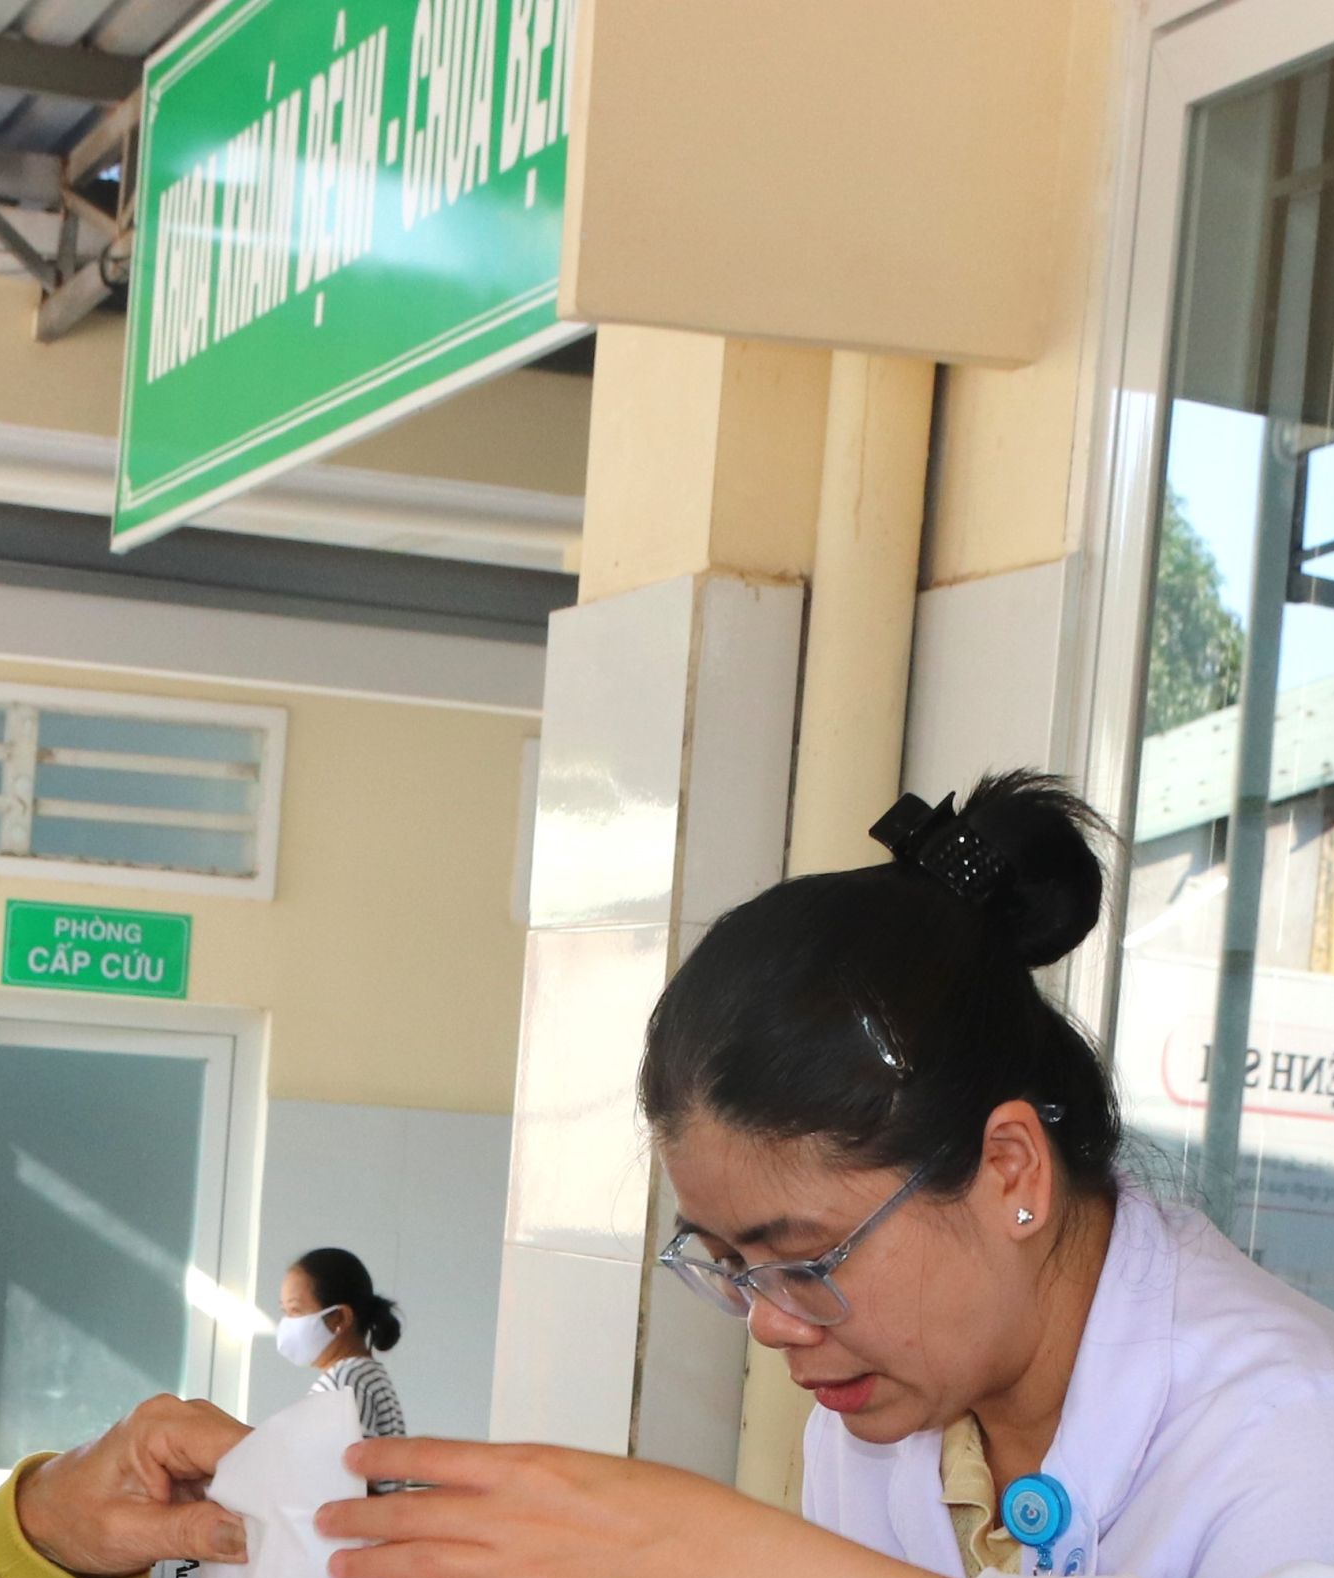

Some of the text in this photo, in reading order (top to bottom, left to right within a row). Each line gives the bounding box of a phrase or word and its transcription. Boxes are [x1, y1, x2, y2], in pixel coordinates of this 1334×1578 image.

[295, 9, 387, 328] BỆNH
[54, 915, 143, 944] PHÒNG
[27, 941, 165, 983] CẤP CỨU
